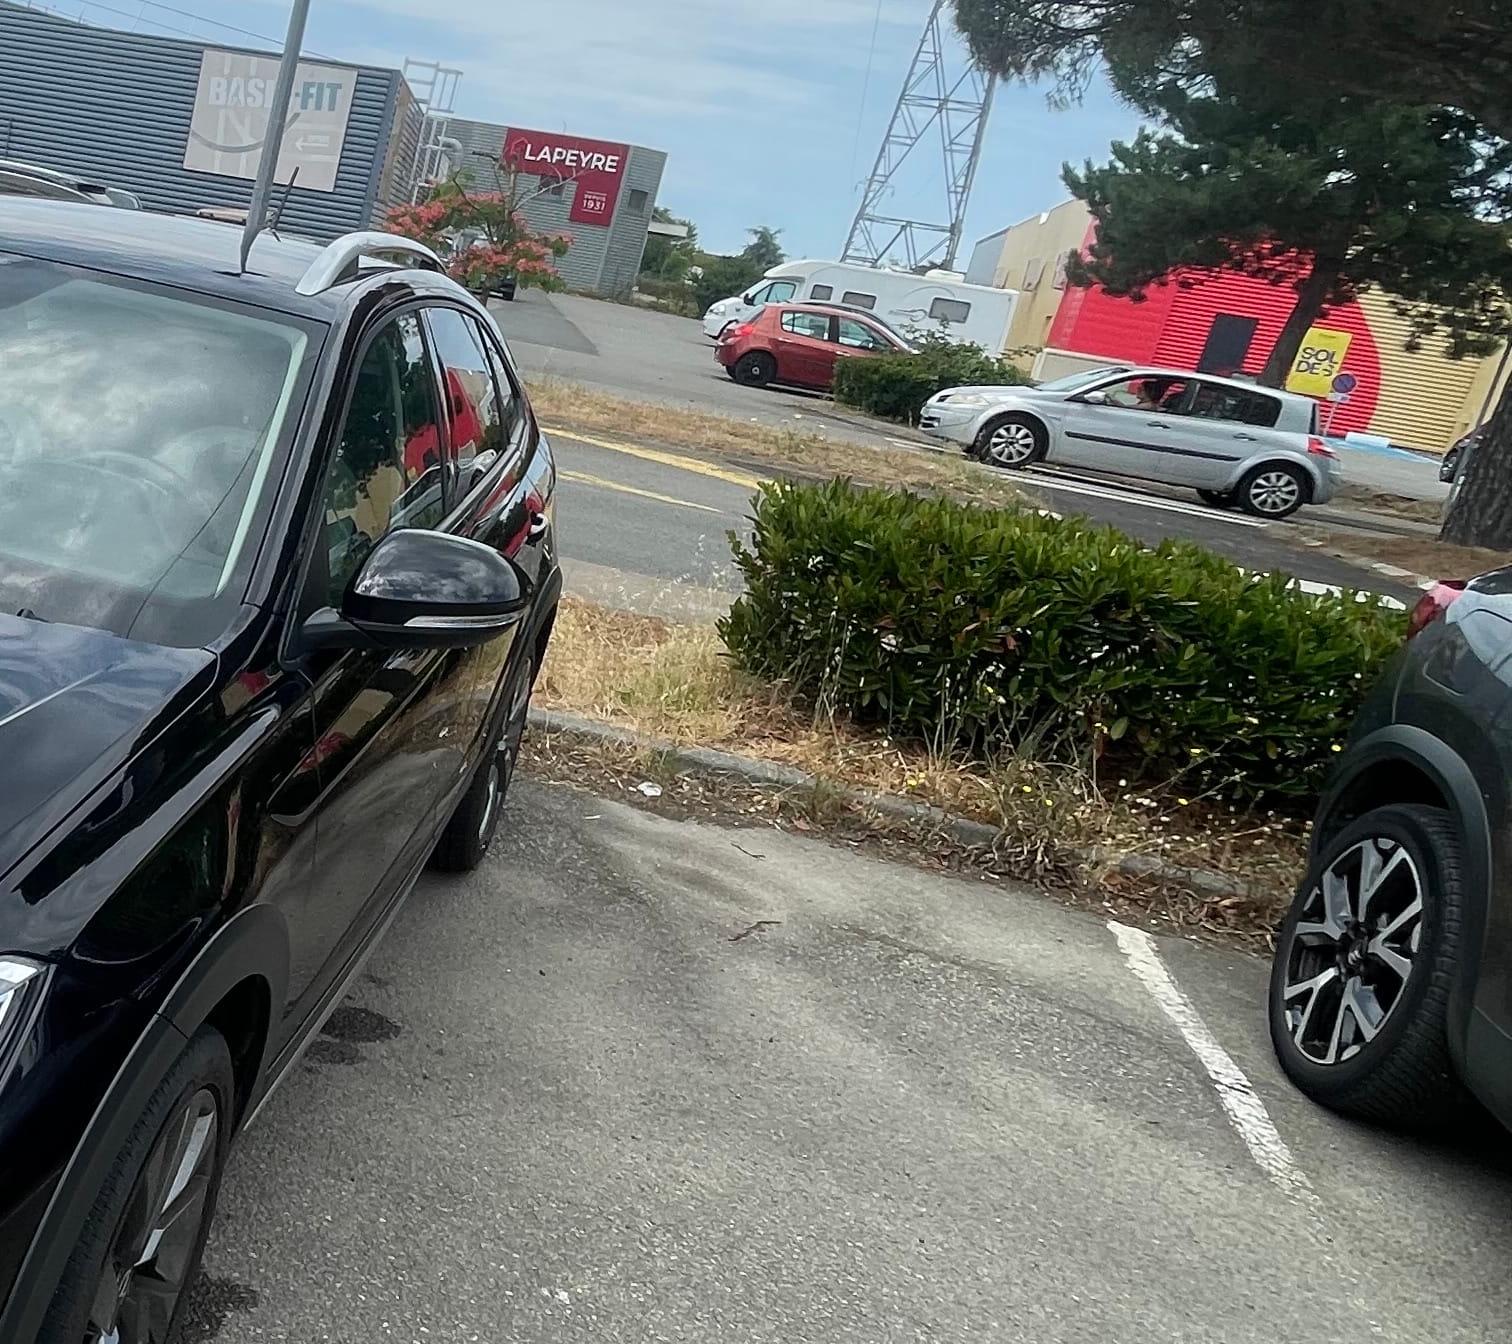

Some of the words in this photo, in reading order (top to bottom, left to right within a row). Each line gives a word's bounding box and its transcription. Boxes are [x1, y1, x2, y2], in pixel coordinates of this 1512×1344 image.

[208, 77, 343, 112] BASI-FIT
[524, 143, 619, 173] LAPEYRE
[1301, 346, 1339, 365] SOL
[1294, 360, 1336, 377] DES
